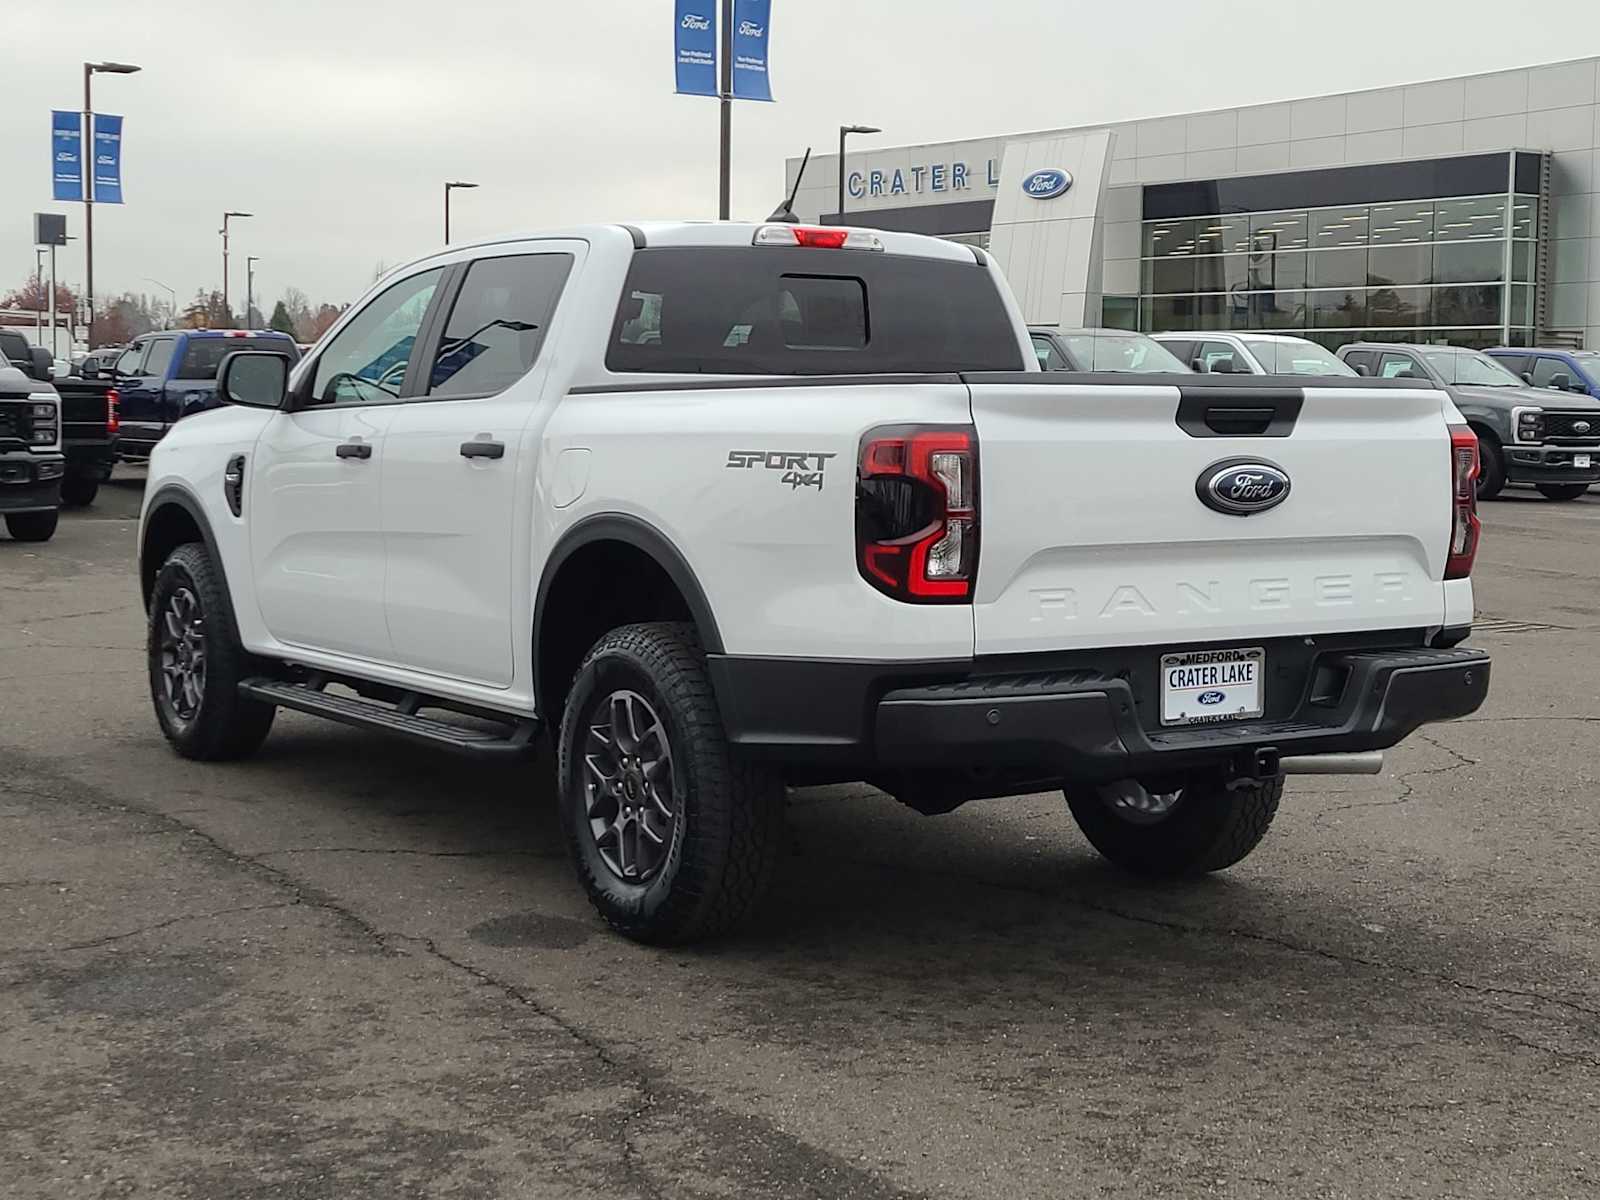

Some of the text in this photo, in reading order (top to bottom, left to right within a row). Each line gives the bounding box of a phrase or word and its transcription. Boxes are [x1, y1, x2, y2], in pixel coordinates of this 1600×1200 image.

[681, 14, 710, 30] Ford
[739, 20, 764, 37] Ford
[848, 162, 970, 198] CRATER
[1029, 174, 1058, 193] Ford
[726, 450, 838, 472] SPORT
[1230, 474, 1274, 499] Ford
[1028, 572, 1413, 622] RANGER
[1186, 650, 1240, 666] MEDFORD
[1169, 663, 1253, 689] CRATER LAKE
[1201, 691, 1222, 705] Ford
